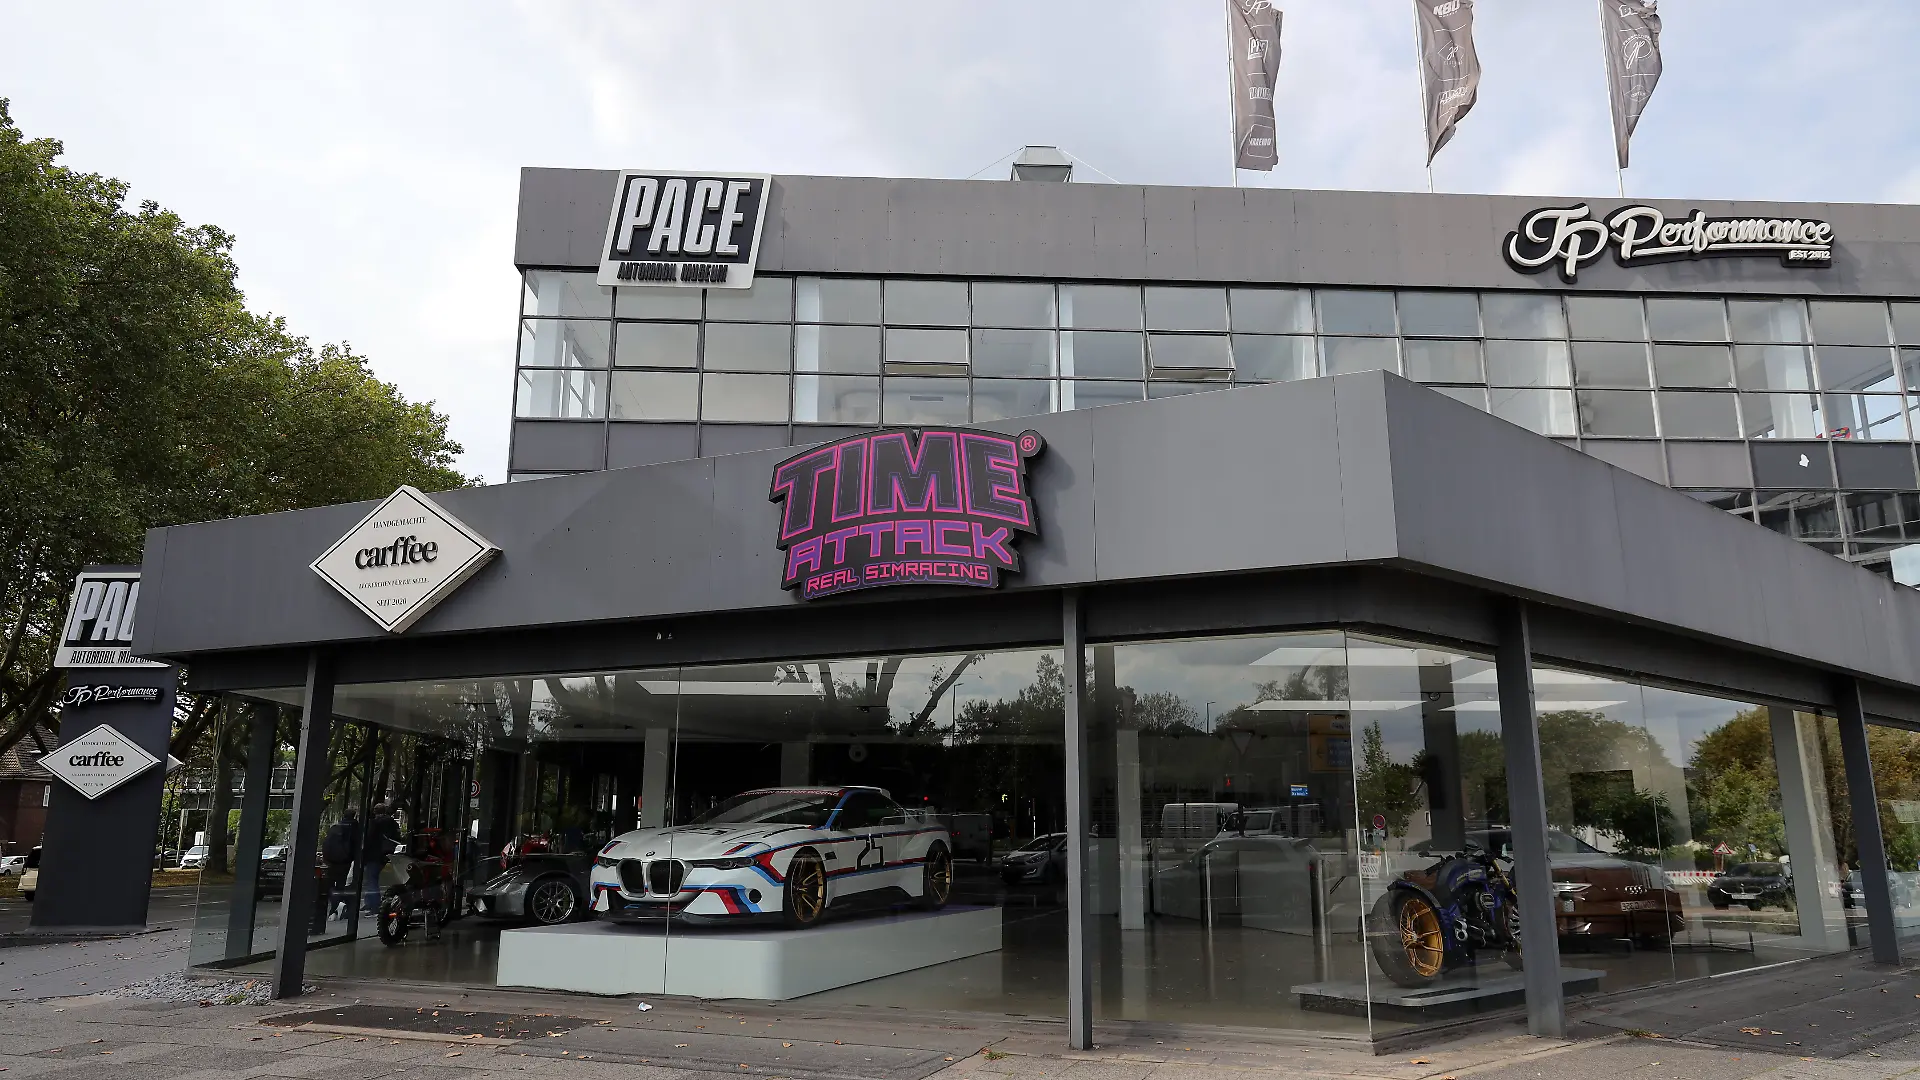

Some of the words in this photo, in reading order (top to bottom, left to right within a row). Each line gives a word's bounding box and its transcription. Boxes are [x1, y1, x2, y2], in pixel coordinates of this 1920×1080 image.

[617, 178, 750, 255] PACE
[1609, 205, 1834, 260] Performance
[617, 262, 677, 281] AUTOMOBIL
[680, 263, 728, 283] MUSEUM
[774, 432, 1030, 540] TIME
[373, 516, 427, 529] HANDGEMACHTE
[355, 535, 439, 570] carffee
[786, 520, 1012, 581] ATTACK
[807, 570, 857, 592] REAL
[865, 562, 989, 580] SIMRACING
[67, 581, 139, 641] PA
[69, 651, 116, 664] AUTOMOBIL
[94, 685, 158, 701] Performance
[69, 751, 125, 766] carffee
[855, 835, 884, 871] 25
